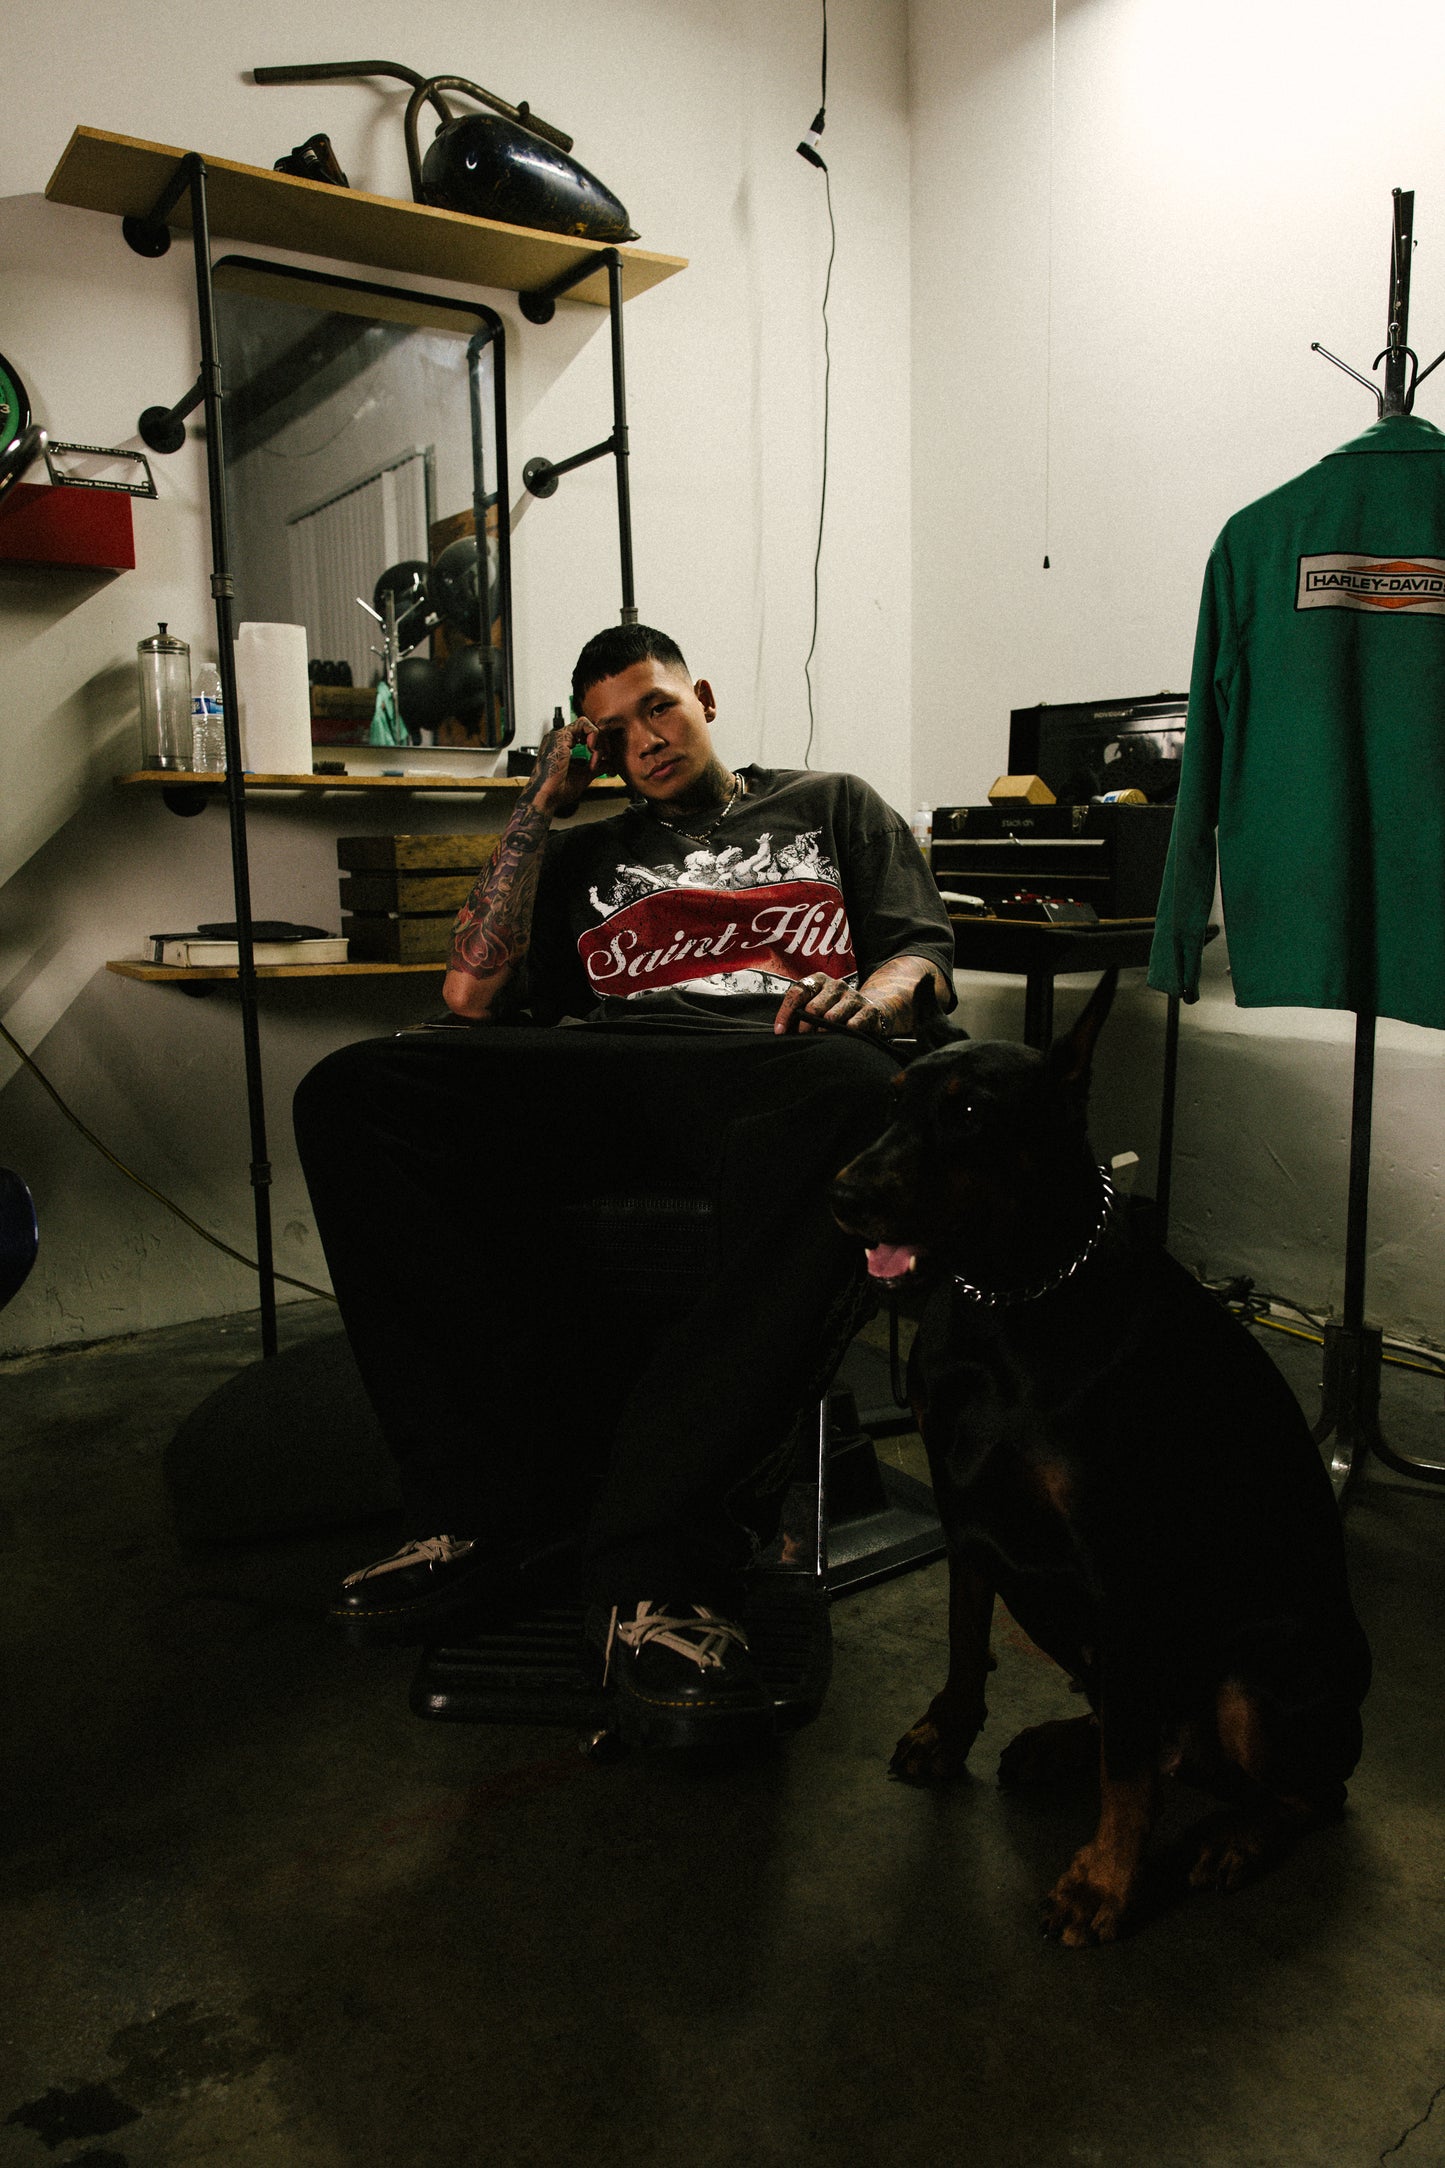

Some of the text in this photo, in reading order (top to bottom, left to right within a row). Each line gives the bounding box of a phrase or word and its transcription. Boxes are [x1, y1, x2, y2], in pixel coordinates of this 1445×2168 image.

[1313, 574, 1445, 592] HARLEY-DAVID
[587, 900, 856, 981] Saint Hill
